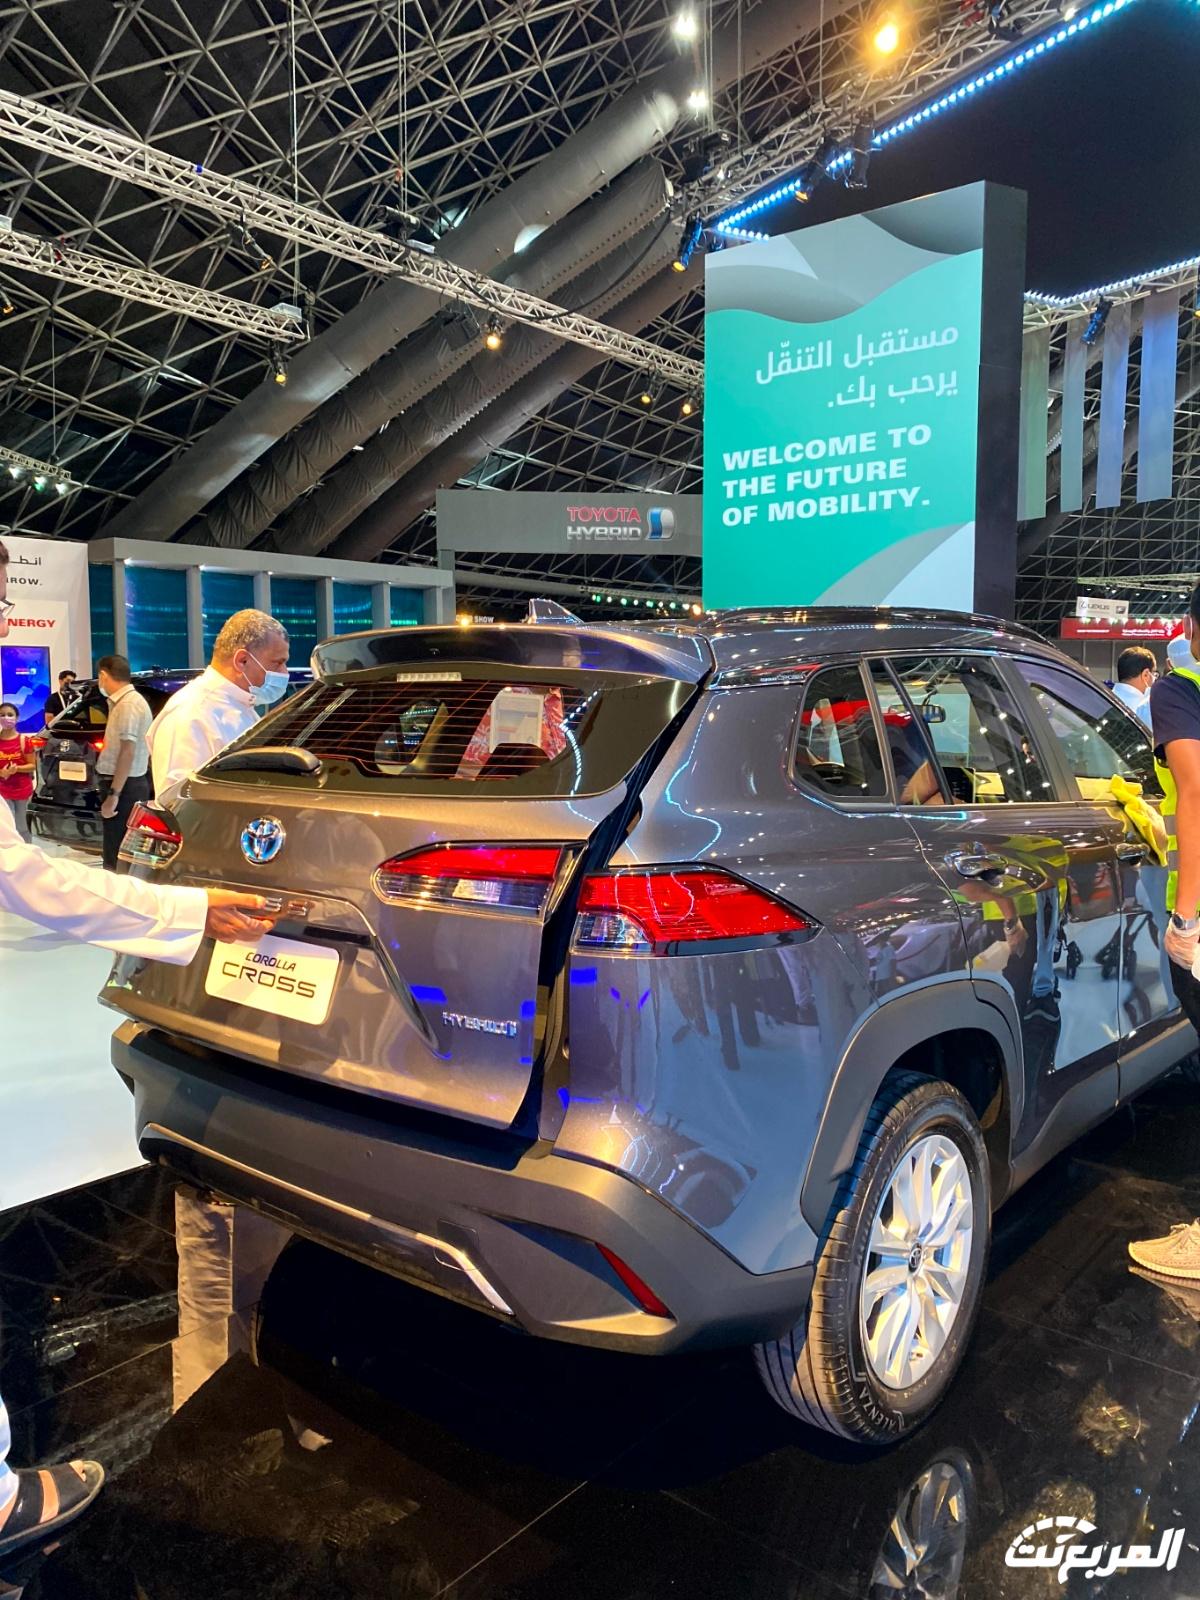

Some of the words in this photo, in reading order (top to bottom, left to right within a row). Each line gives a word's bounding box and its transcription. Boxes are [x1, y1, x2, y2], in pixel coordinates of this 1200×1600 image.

[756, 340, 832, 384] التنقّل
[843, 327, 959, 369] مستقبل
[827, 376, 876, 408] بك.
[888, 371, 958, 404] يرحب
[723, 431, 877, 472] WELCOME
[888, 424, 932, 448] TO
[722, 474, 776, 499] THE
[786, 457, 907, 491] FUTURE
[566, 506, 641, 522] TOYOTA
[722, 505, 758, 527] OF
[768, 486, 930, 522] MOBILITY.
[566, 525, 641, 540] HYBRID
[245, 951, 297, 972] COROLLA
[221, 961, 317, 999] CROSS
[442, 1011, 507, 1034] HYBRID
